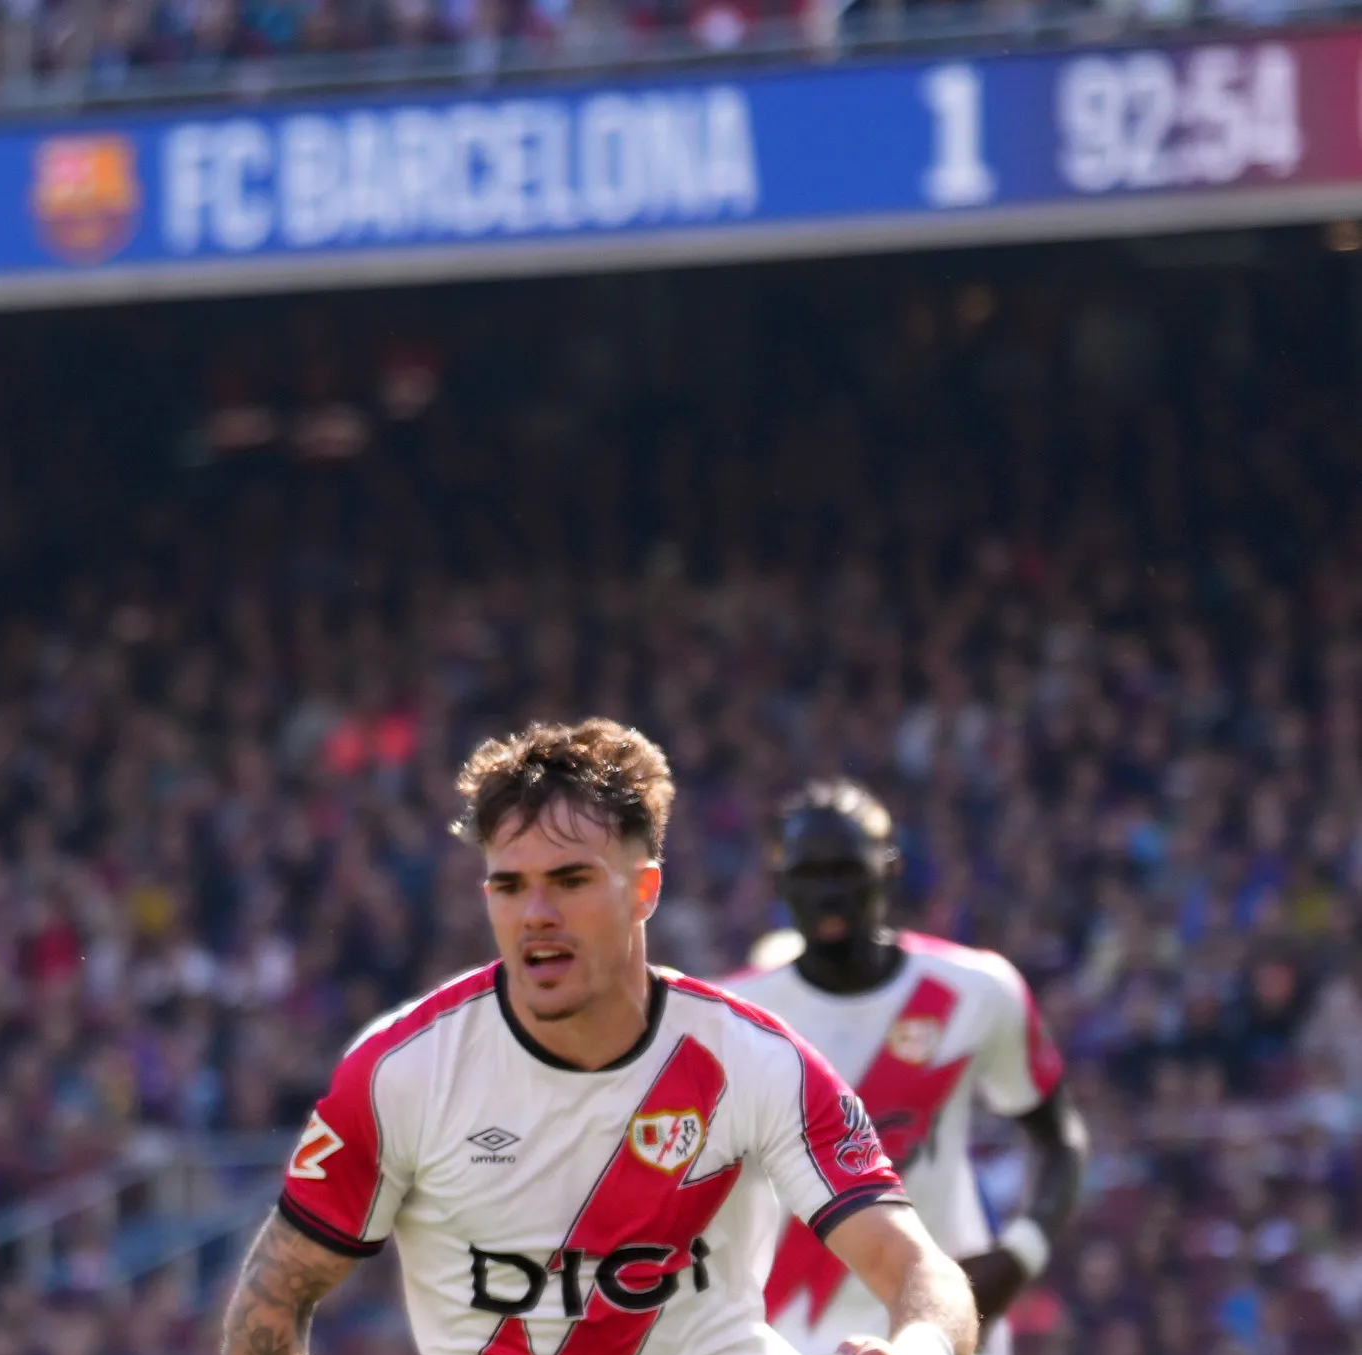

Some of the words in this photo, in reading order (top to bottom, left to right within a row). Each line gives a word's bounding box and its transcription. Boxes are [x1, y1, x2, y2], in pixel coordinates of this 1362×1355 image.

[162, 110, 272, 252] FC
[280, 86, 760, 250] BARCELONA
[922, 62, 994, 206] 1
[470, 1153, 516, 1164] umbro
[469, 1237, 711, 1318] DIGI
